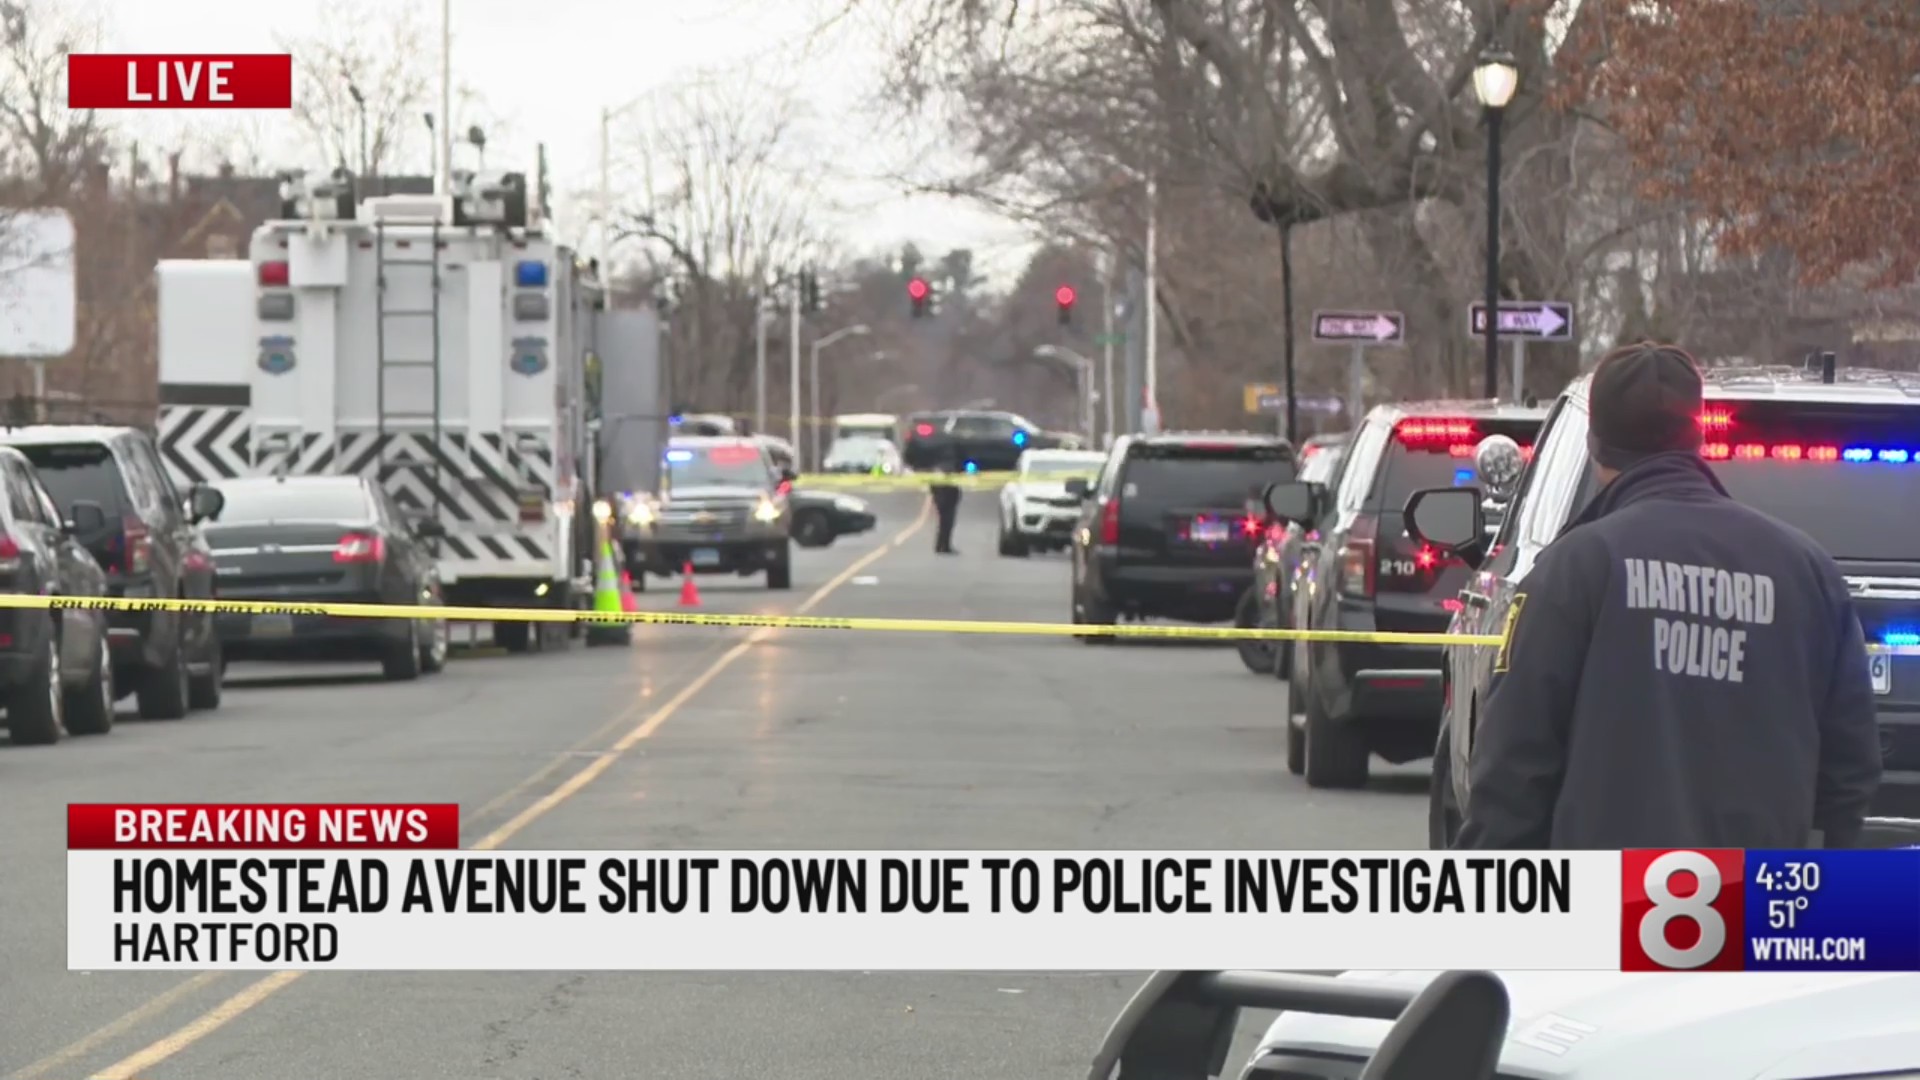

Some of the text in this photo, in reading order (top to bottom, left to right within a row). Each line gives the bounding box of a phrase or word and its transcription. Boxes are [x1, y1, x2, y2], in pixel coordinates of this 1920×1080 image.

[1380, 559, 1415, 576] 210
[49, 600, 117, 611] POLICE
[127, 602, 168, 612] LINE
[1625, 558, 1775, 625] HARTFORD
[1654, 617, 1747, 683] POLICE
